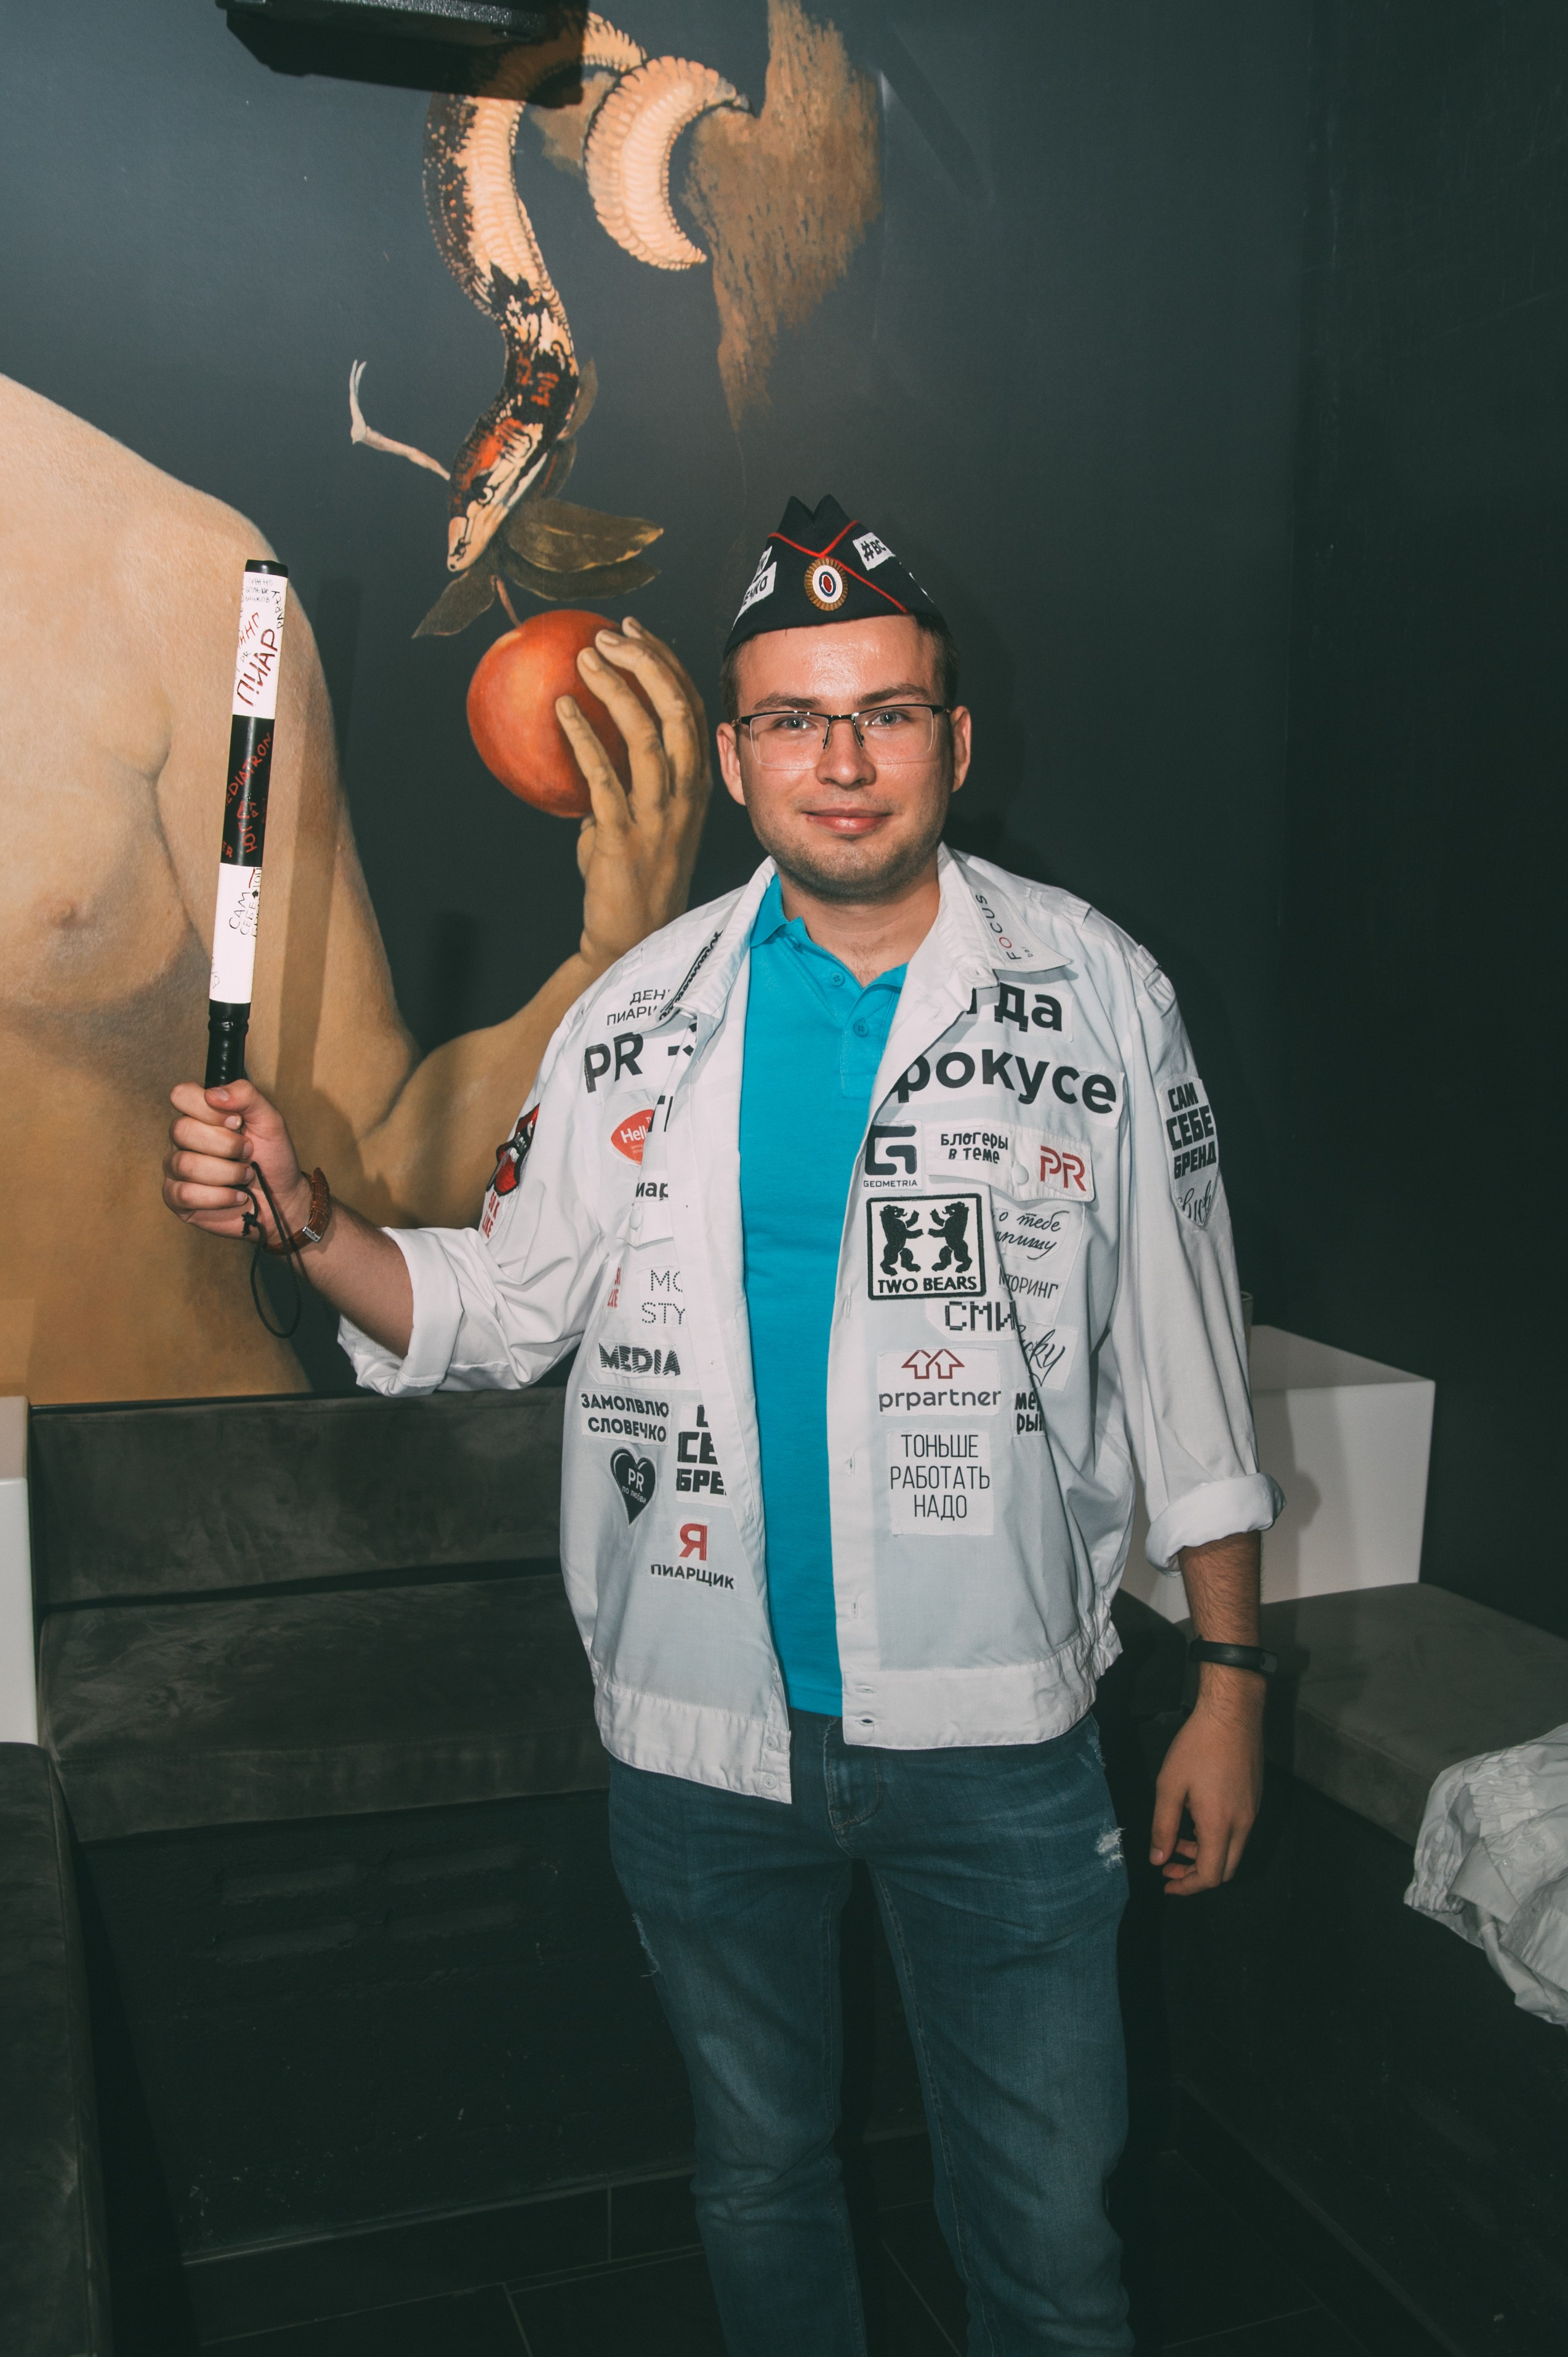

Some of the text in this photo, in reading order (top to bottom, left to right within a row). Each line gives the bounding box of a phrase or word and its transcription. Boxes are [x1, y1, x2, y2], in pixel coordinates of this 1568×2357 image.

[976, 895, 1022, 960] FOCUS
[629, 989, 670, 1005] ДЕН
[584, 1032, 644, 1094] PR
[1168, 1082, 1199, 1113] САМ
[620, 1125, 649, 1143] Hell
[941, 1132, 1009, 1150] Блогеры
[1166, 1105, 1215, 1151] СЕБЕ
[948, 1147, 1000, 1164] в теме
[1040, 1145, 1087, 1192] PR
[1173, 1140, 1217, 1180] БРЕНД
[863, 1179, 918, 1188] GEOMETRIA
[1016, 1210, 1070, 1232] тебе
[877, 1276, 978, 1294] TWO BEARS
[944, 1300, 1018, 1332] СМИ
[598, 1342, 681, 1377] MEDIA
[581, 1393, 670, 1418] ЗАМОЛВЛЮ
[878, 1388, 1002, 1412] prpartner
[587, 1416, 667, 1443] СЛОВЕЧКО
[901, 1434, 979, 1458] ТОНЬШЕ
[628, 1467, 645, 1493] PR
[676, 1468, 727, 1496] БРЕ
[890, 1465, 990, 1490] РАБОТАТЬ
[914, 1494, 967, 1521] НАДО
[678, 1523, 708, 1561] Я
[650, 1563, 735, 1590] ПИАРЩИК
